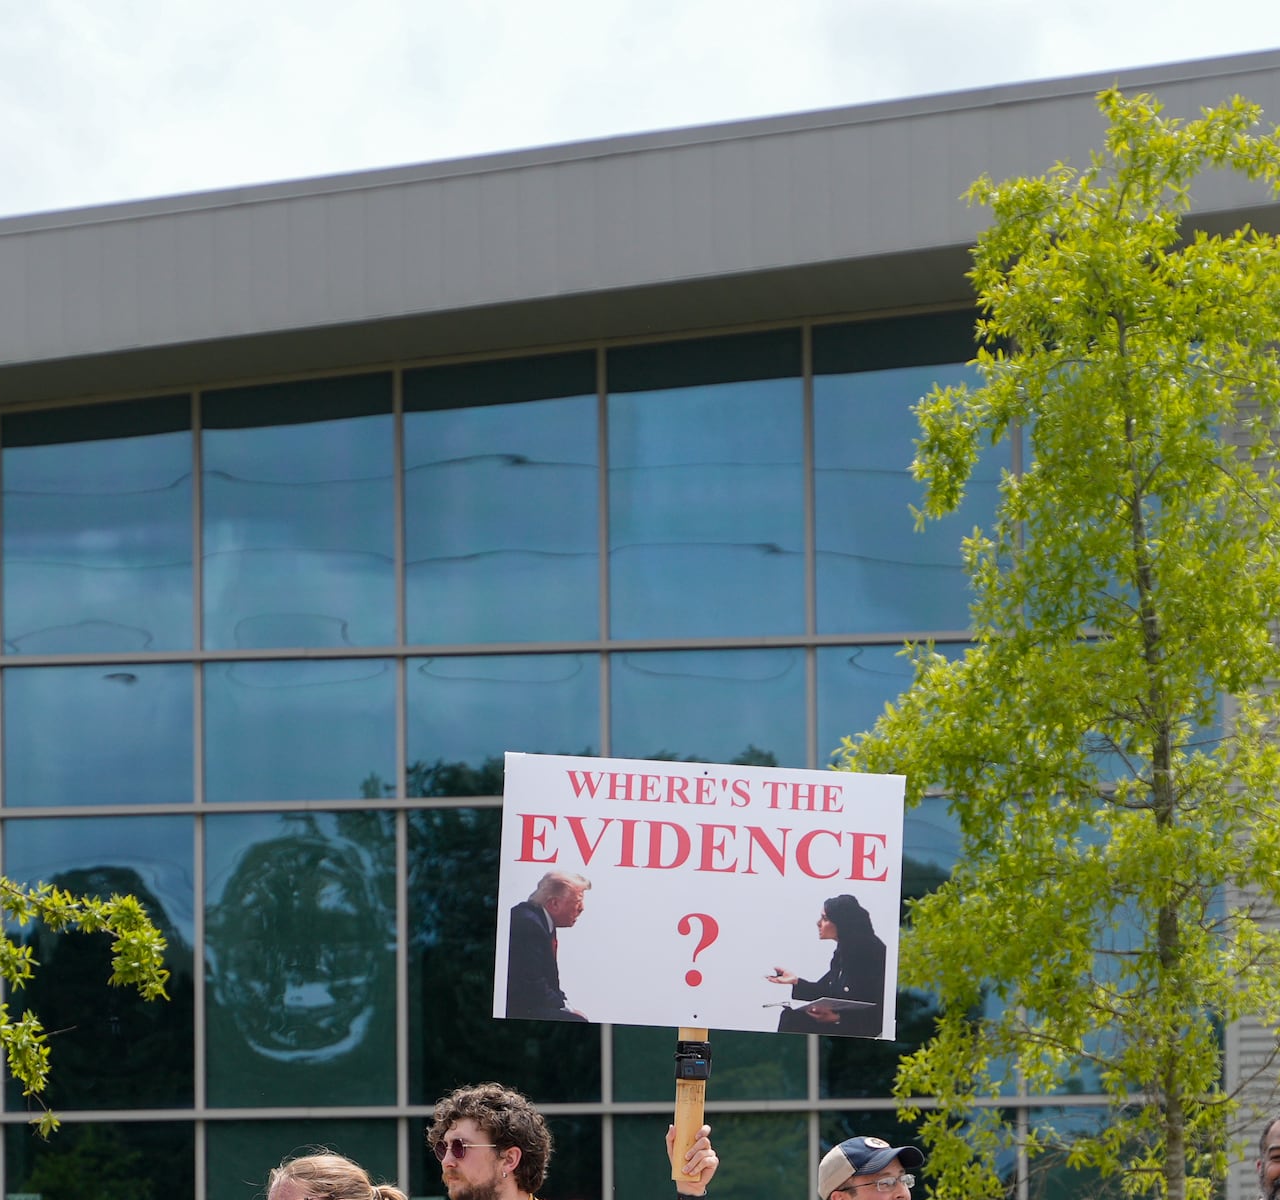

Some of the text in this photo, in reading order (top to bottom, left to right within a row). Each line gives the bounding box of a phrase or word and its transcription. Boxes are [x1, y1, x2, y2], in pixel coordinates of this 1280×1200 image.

[566, 769, 845, 813] WHERE'S THE
[514, 813, 889, 882] EVIDENCE
[677, 912, 719, 987] ?
